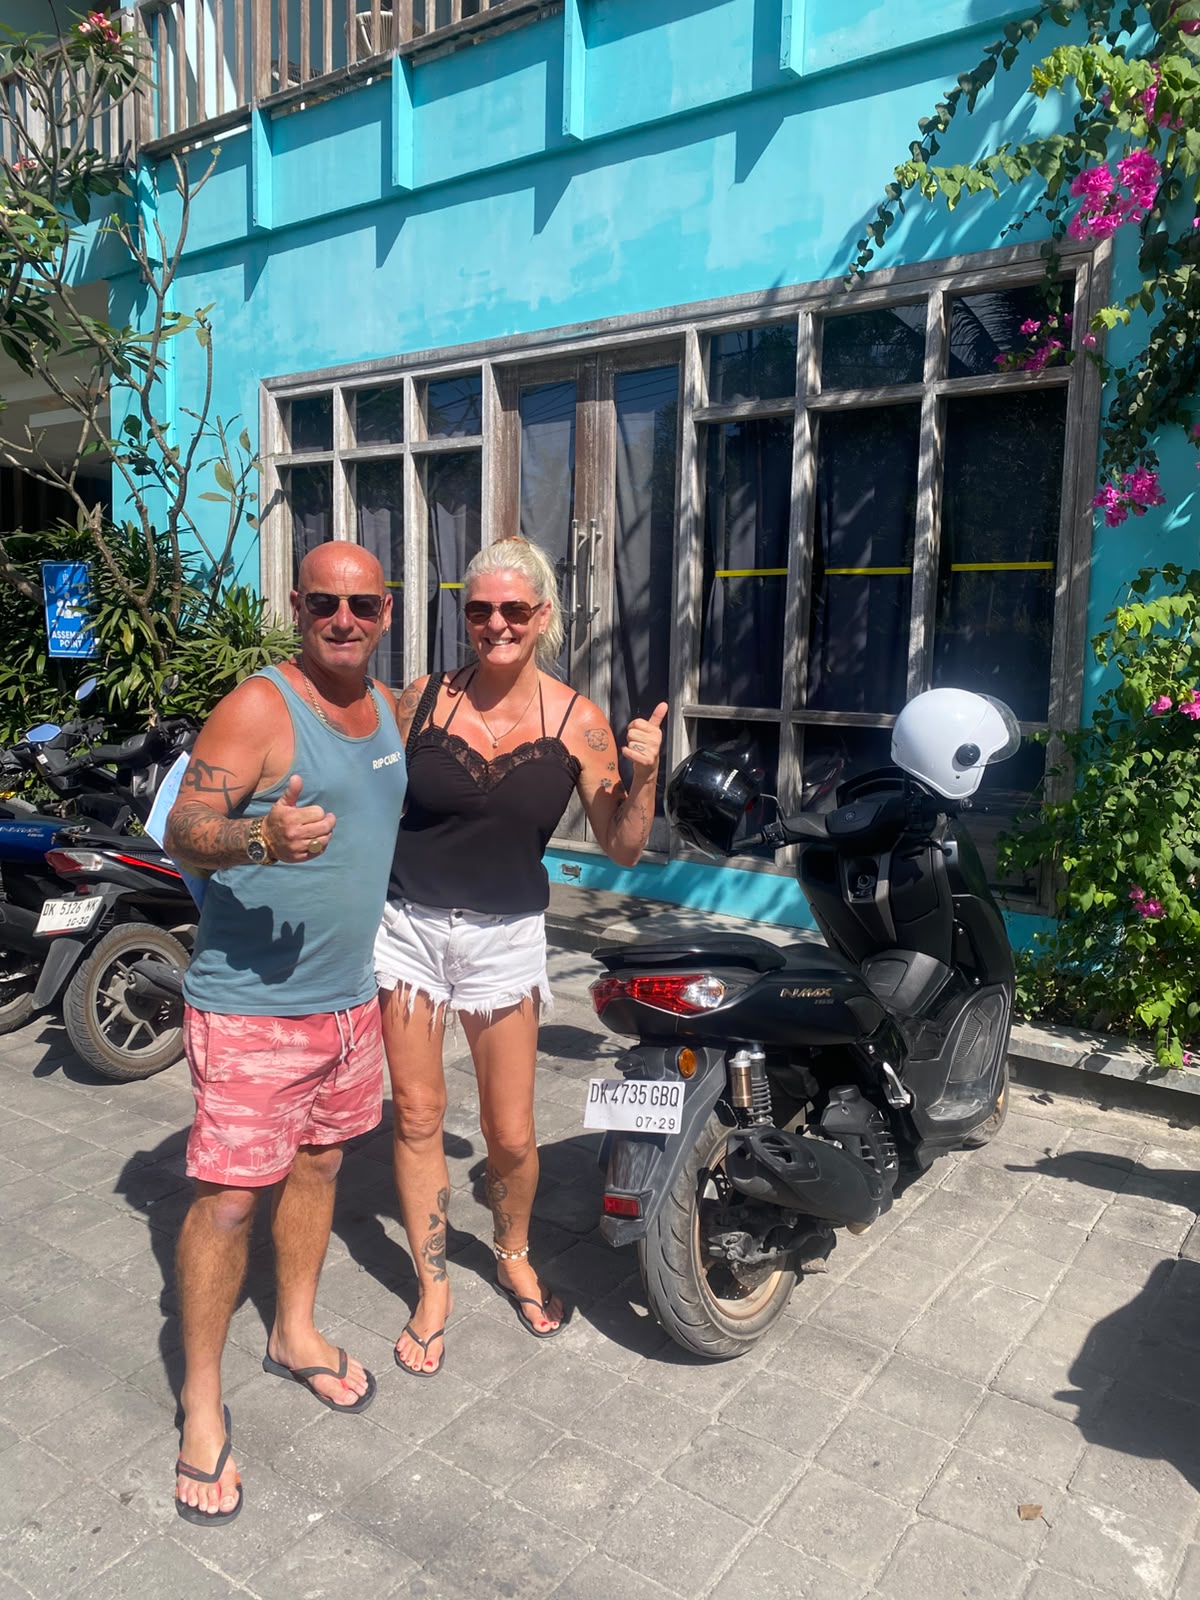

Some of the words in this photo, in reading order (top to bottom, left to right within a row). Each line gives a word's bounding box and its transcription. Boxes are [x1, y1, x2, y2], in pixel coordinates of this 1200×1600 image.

[59, 639, 83, 649] POINT
[43, 903, 57, 916] DK
[590, 1083, 608, 1104] DK
[611, 1084, 647, 1105] 4735
[650, 1085, 680, 1107] GBQ
